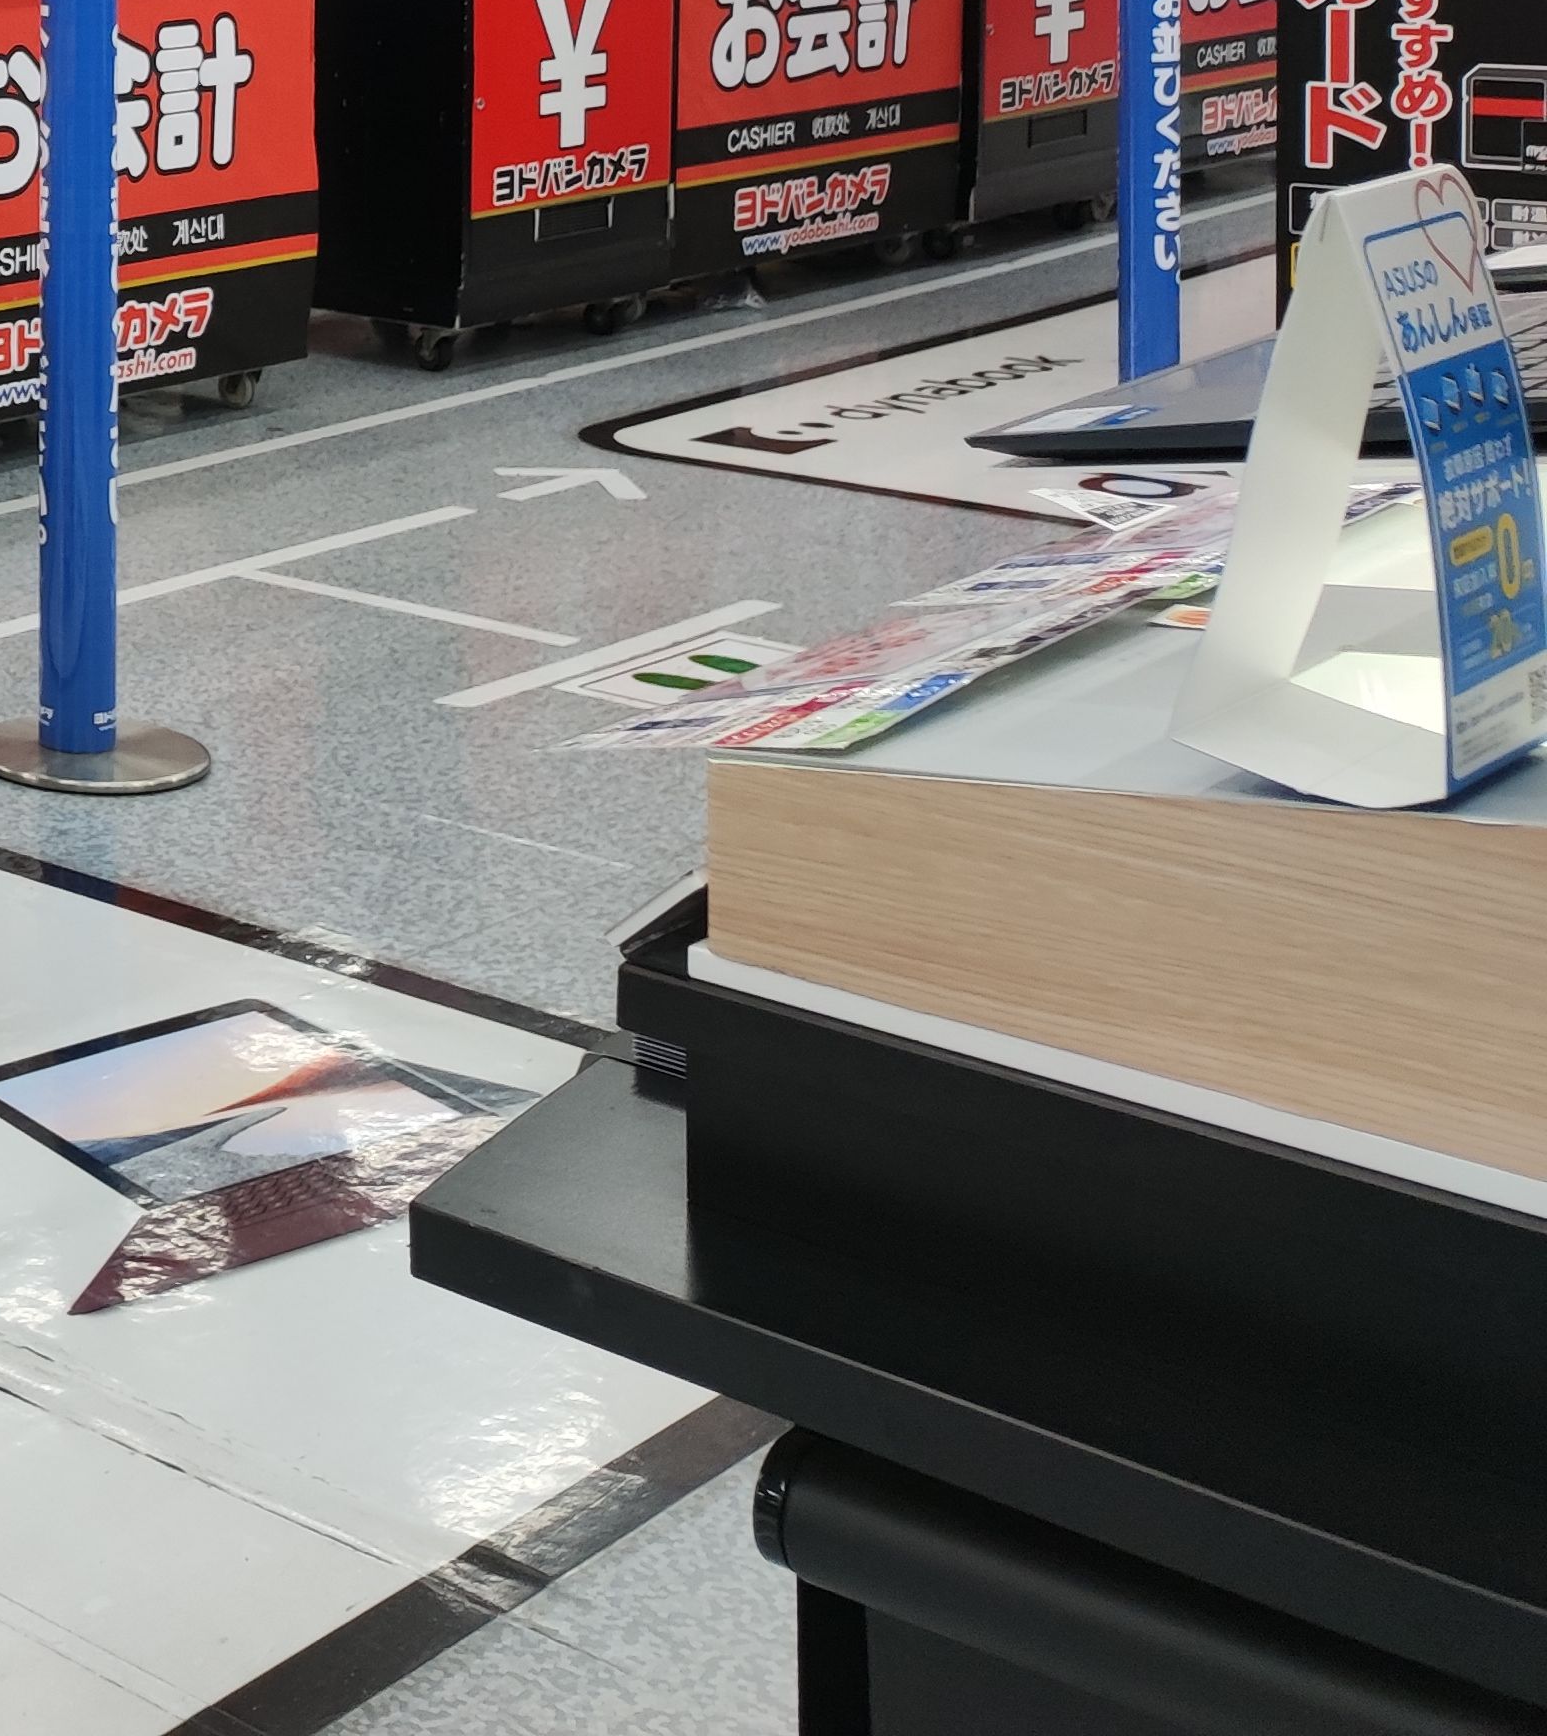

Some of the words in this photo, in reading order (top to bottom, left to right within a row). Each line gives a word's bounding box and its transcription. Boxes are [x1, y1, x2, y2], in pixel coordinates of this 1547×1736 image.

[1196, 42, 1247, 67] CASHIER
[1000, 60, 1118, 113] ヨドバシカメラ
[727, 121, 796, 155] CASHIER
[743, 211, 880, 257] www.yodobashi.com
